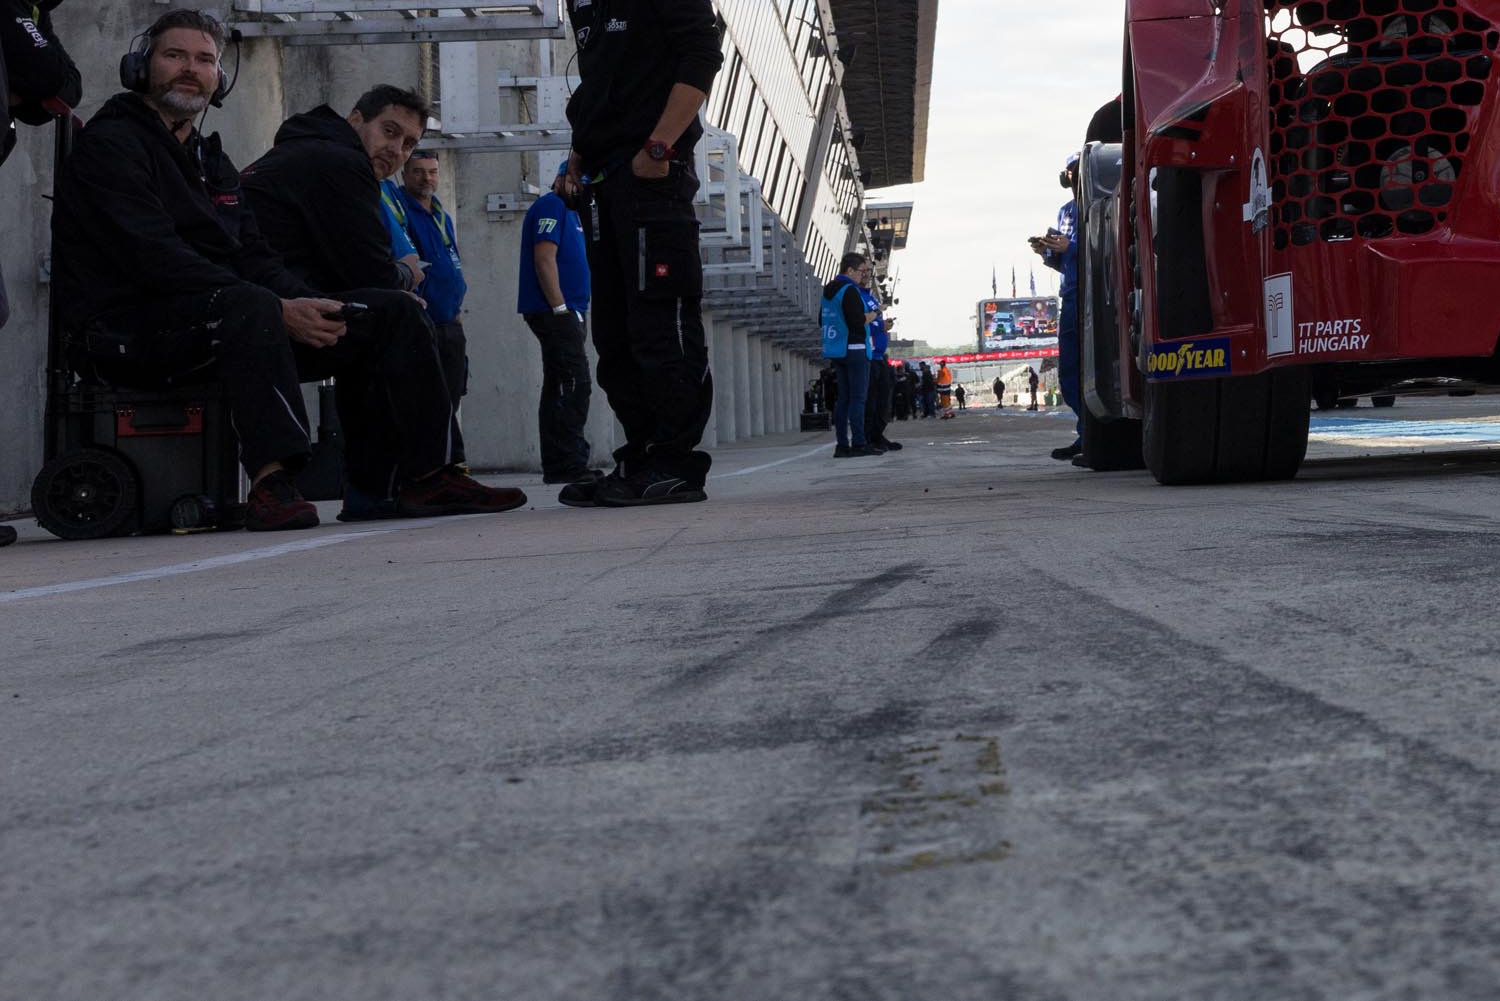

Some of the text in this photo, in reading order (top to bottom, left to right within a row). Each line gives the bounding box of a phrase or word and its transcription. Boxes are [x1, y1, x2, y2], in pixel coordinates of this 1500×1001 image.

[537, 217, 558, 234] 77
[1299, 319, 1362, 338] TT PARTS
[1299, 334, 1371, 354] HUNGARY
